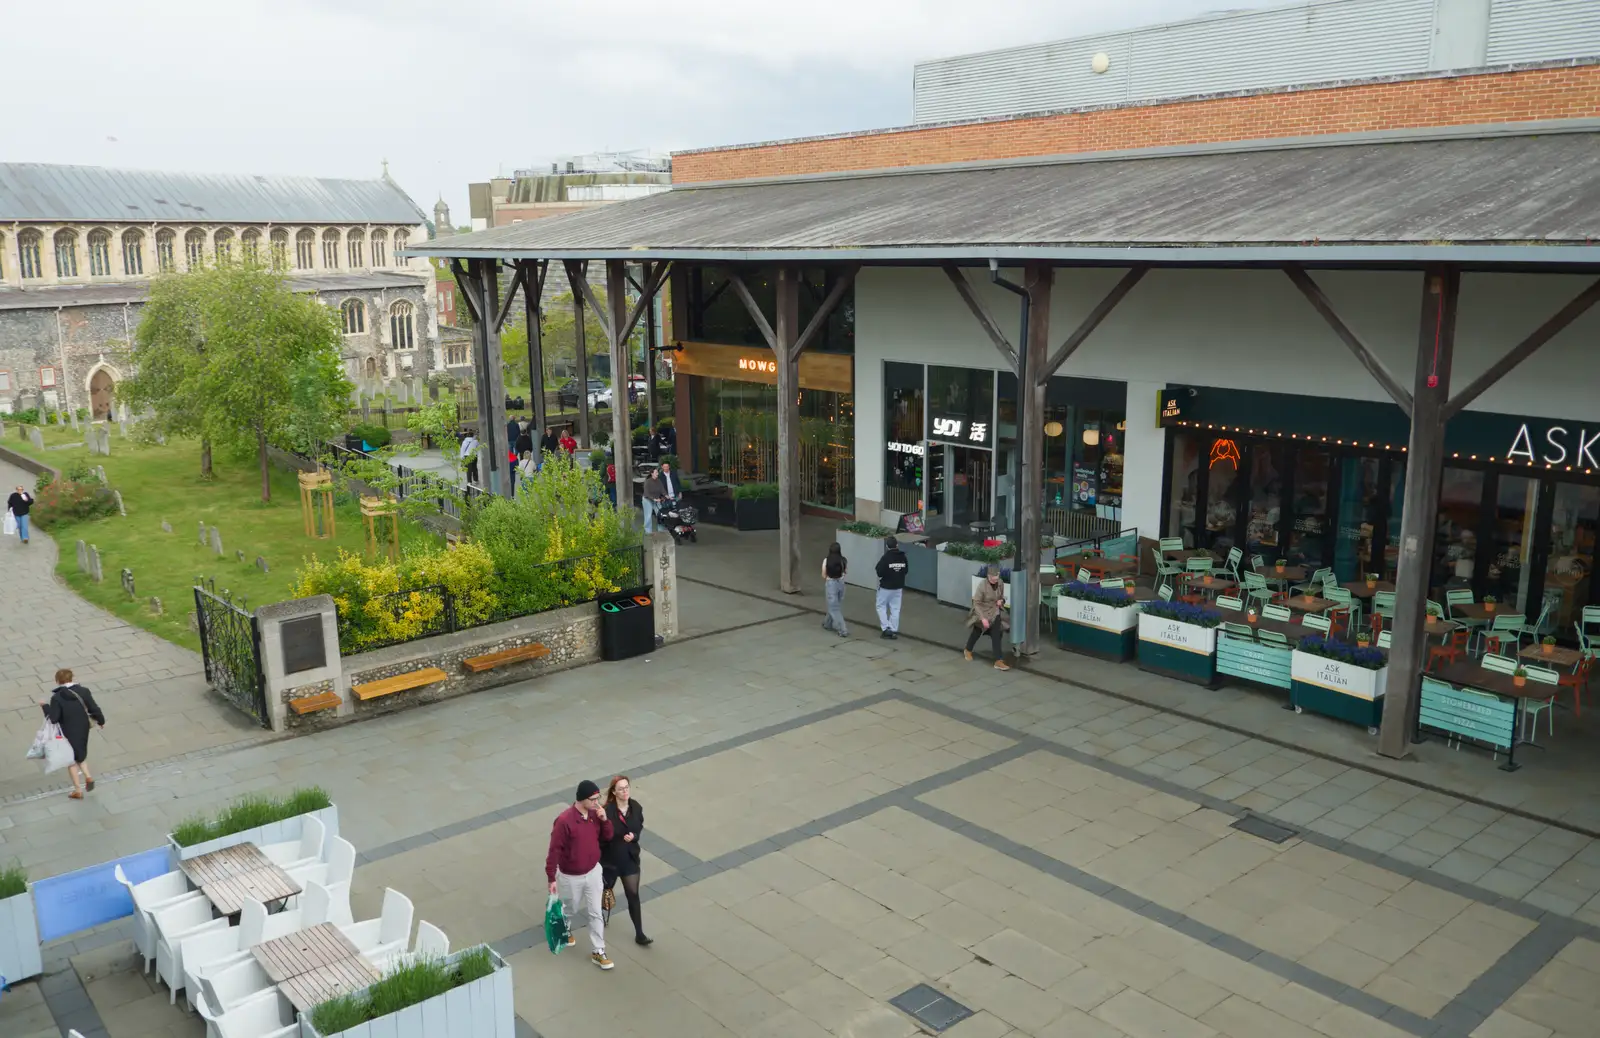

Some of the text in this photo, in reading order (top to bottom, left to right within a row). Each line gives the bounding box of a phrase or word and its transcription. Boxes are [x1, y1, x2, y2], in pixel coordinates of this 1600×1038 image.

[1167, 399, 1177, 407] ASK
[1162, 408, 1181, 417] ITALIAN
[932, 417, 961, 437] YO!
[1507, 423, 1600, 469] ASK
[1083, 605, 1095, 613] ASK
[1076, 612, 1101, 622] ITALIAN
[1167, 624, 1181, 632] ASK
[1160, 632, 1187, 643] ITALIAN
[1324, 664, 1341, 673] ASK
[1316, 671, 1348, 685] ITALIAN
